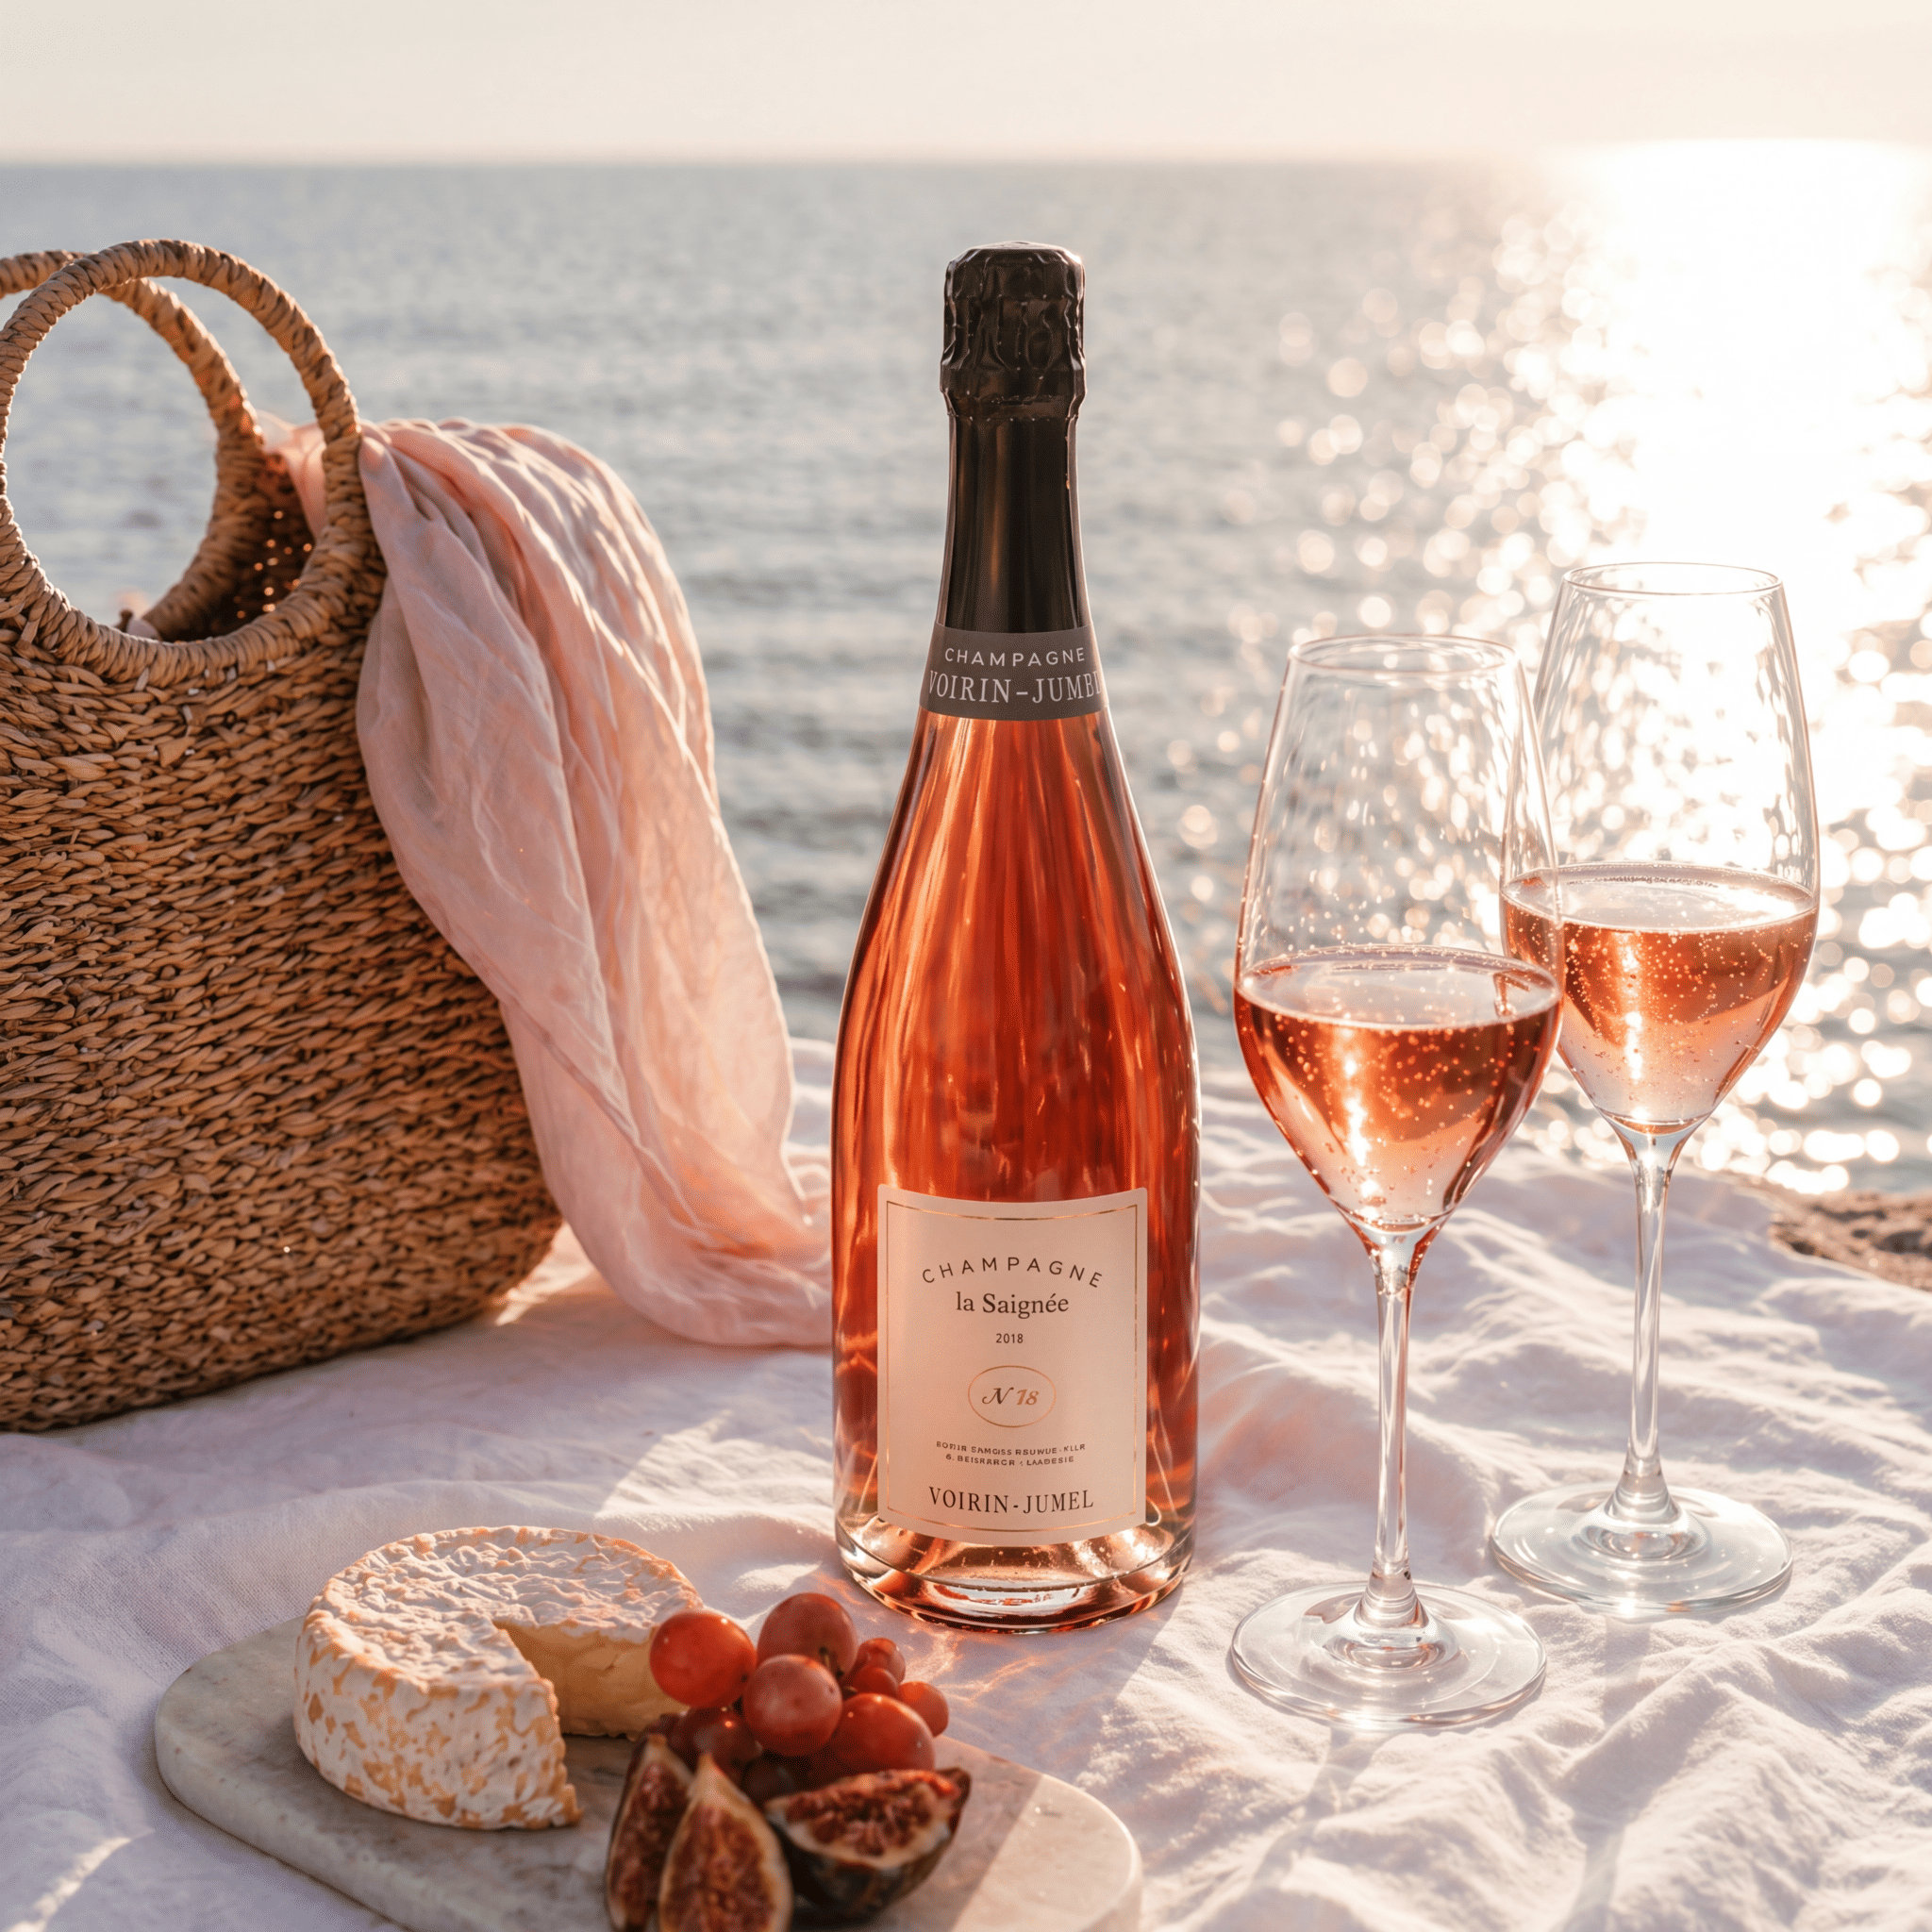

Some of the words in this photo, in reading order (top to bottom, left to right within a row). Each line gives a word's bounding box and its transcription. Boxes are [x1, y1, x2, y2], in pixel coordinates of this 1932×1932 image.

[945, 647, 1085, 666] CHAMPAGNE
[923, 1257, 1102, 1288] CHAMPAGNE
[956, 1291, 975, 1312] la
[982, 1292, 1070, 1319] Saignée
[995, 1333, 1024, 1344] 2018
